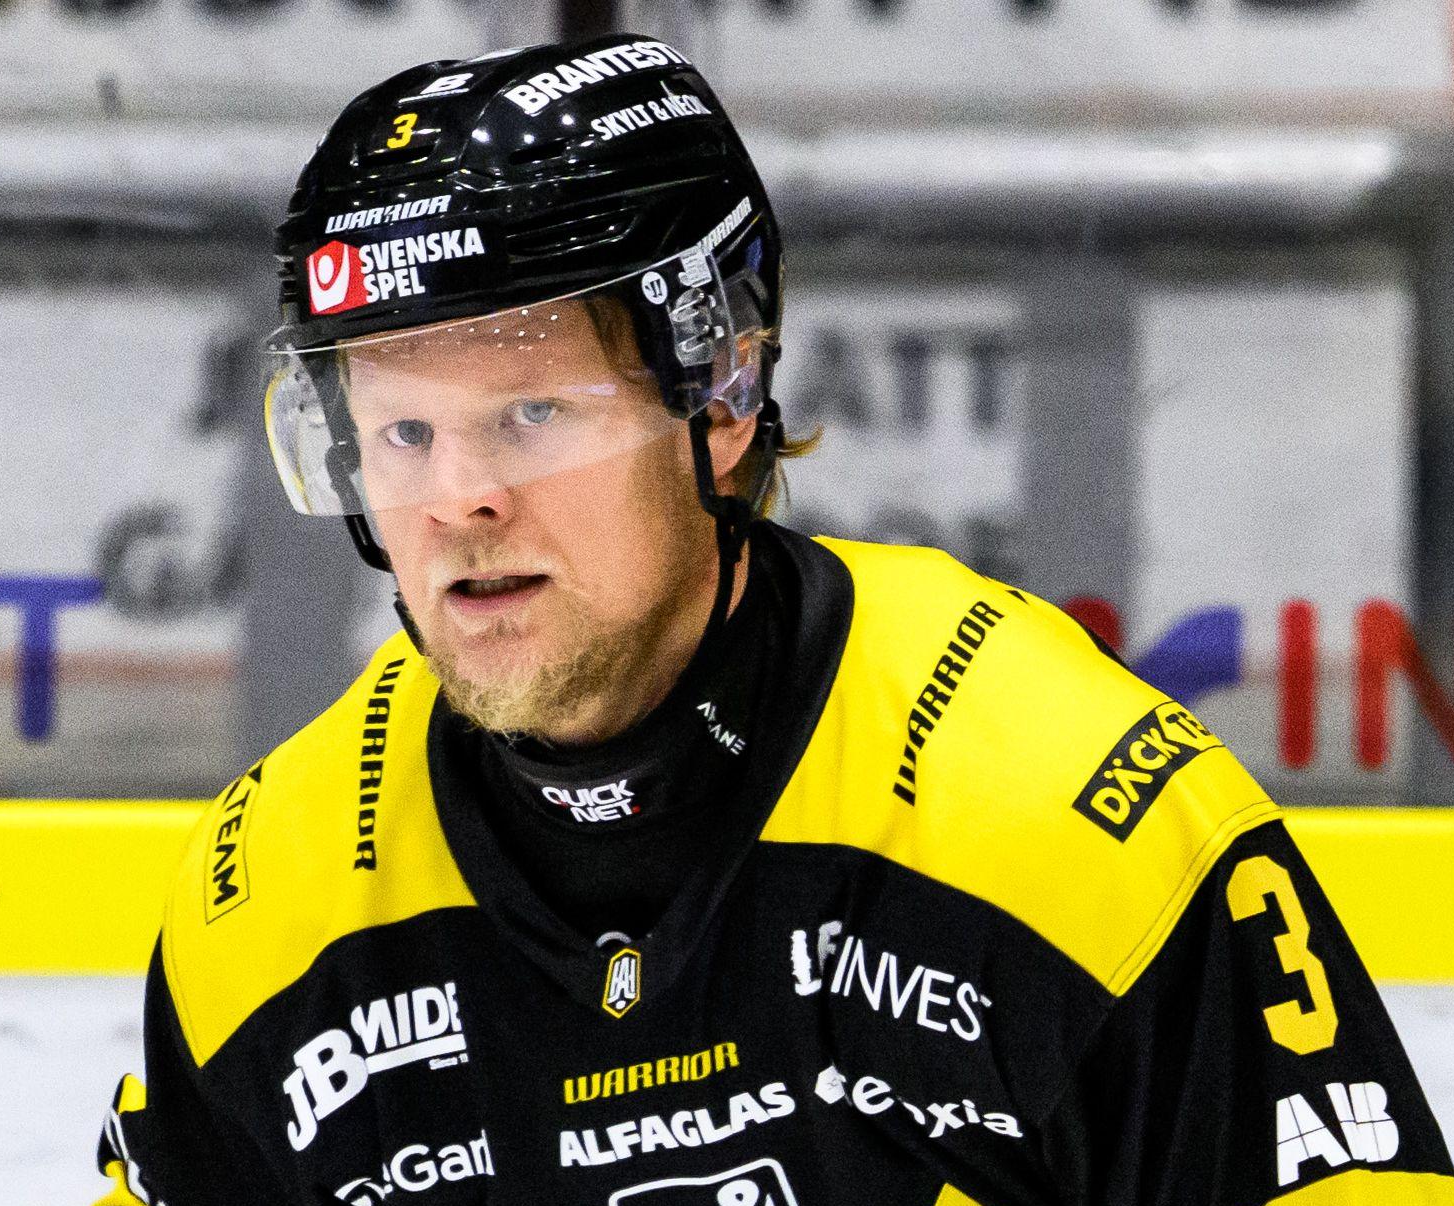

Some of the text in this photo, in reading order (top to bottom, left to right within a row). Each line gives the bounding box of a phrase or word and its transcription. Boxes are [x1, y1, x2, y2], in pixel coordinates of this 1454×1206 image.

[386, 113, 418, 149] 3
[590, 104, 655, 141] SKYLT
[648, 100, 672, 121] &
[325, 195, 452, 234] WARRIOR
[359, 227, 485, 274] SVENSKA
[363, 266, 426, 304] SPEL
[893, 600, 1006, 807] WARRIOR
[353, 658, 407, 871] WARRIOR
[541, 780, 635, 807] QUICK
[1226, 855, 1338, 1056] 3
[830, 936, 993, 1042] INVES
[563, 1042, 740, 1104] WARRIOR
[559, 1082, 796, 1167] ALFAGLAS
